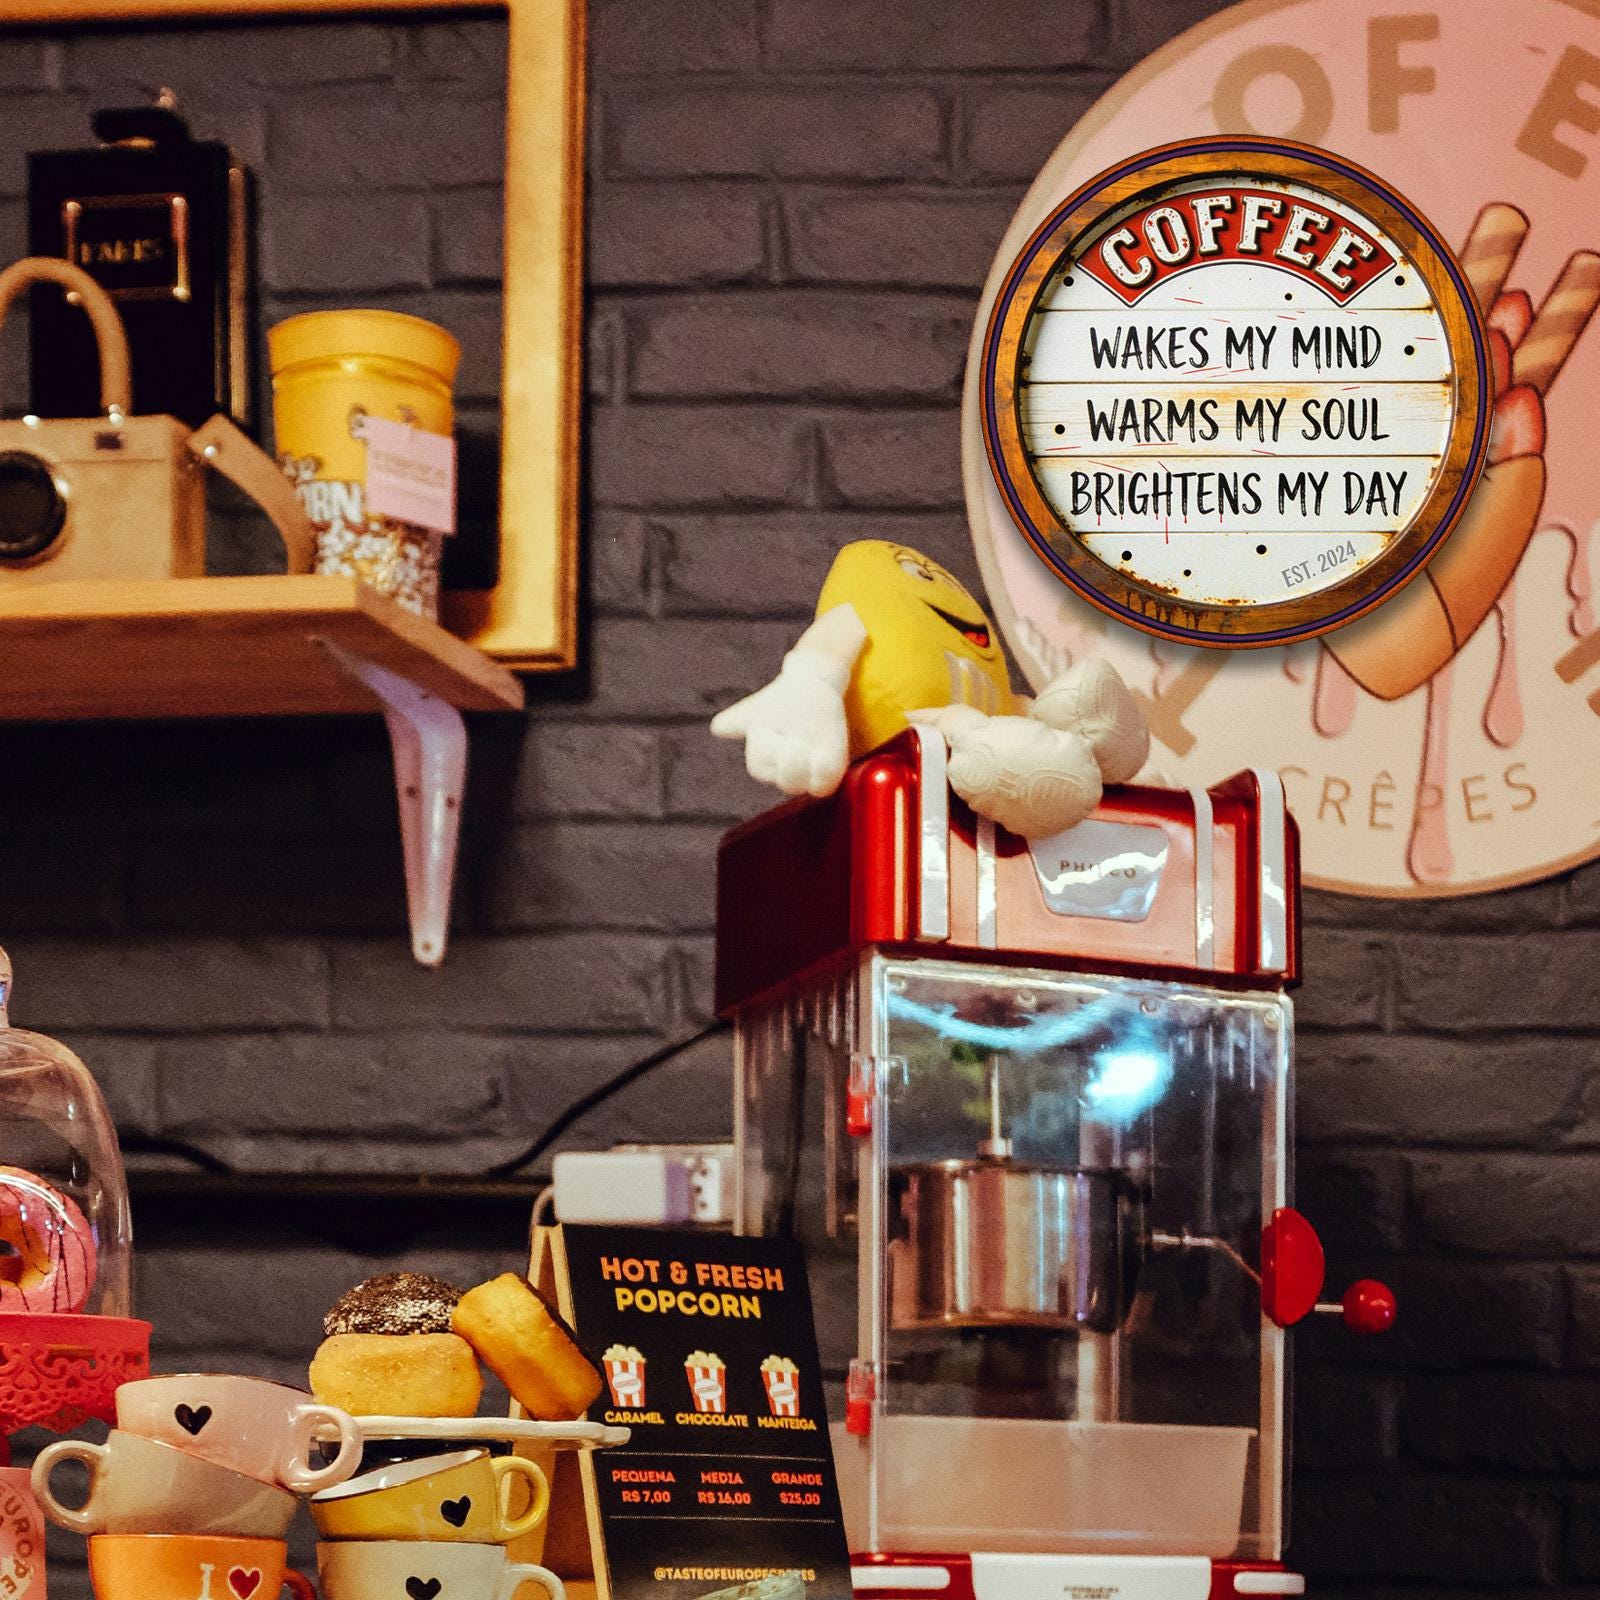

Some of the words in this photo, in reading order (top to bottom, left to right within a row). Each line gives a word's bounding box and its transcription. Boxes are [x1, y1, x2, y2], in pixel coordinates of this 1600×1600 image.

[1100, 195, 1375, 292] COFFEE
[1089, 325, 1209, 370] WAKES
[1225, 325, 1277, 371] MY
[1292, 325, 1382, 370] MIND
[1087, 398, 1219, 443] WARMS
[1236, 398, 1287, 443] MY
[1302, 398, 1390, 442] SOUL
[1070, 471, 1262, 517] BRIGHTENS
[1278, 471, 1329, 517] MY
[1343, 471, 1408, 517] DAY
[1281, 560, 1316, 588] EST.
[1317, 540, 1357, 573] 2024
[1060, 860, 1136, 879] PHICO
[600, 1256, 661, 1283] HOT
[669, 1261, 688, 1285] &
[694, 1263, 785, 1292] FRESH
[614, 1287, 762, 1319] POPCORN
[604, 1411, 665, 1425] CARAMEL
[675, 1412, 749, 1428] CHOCOLATE
[757, 1416, 817, 1431] MANTEIGA
[700, 1471, 744, 1485] MEDIA
[771, 1471, 823, 1486] GRANDE
[642, 1490, 671, 1504] 7,00
[717, 1491, 752, 1505] 16,00
[199, 1563, 216, 1600] I
[654, 1567, 817, 1582] @TASTEOFEUROPEES
